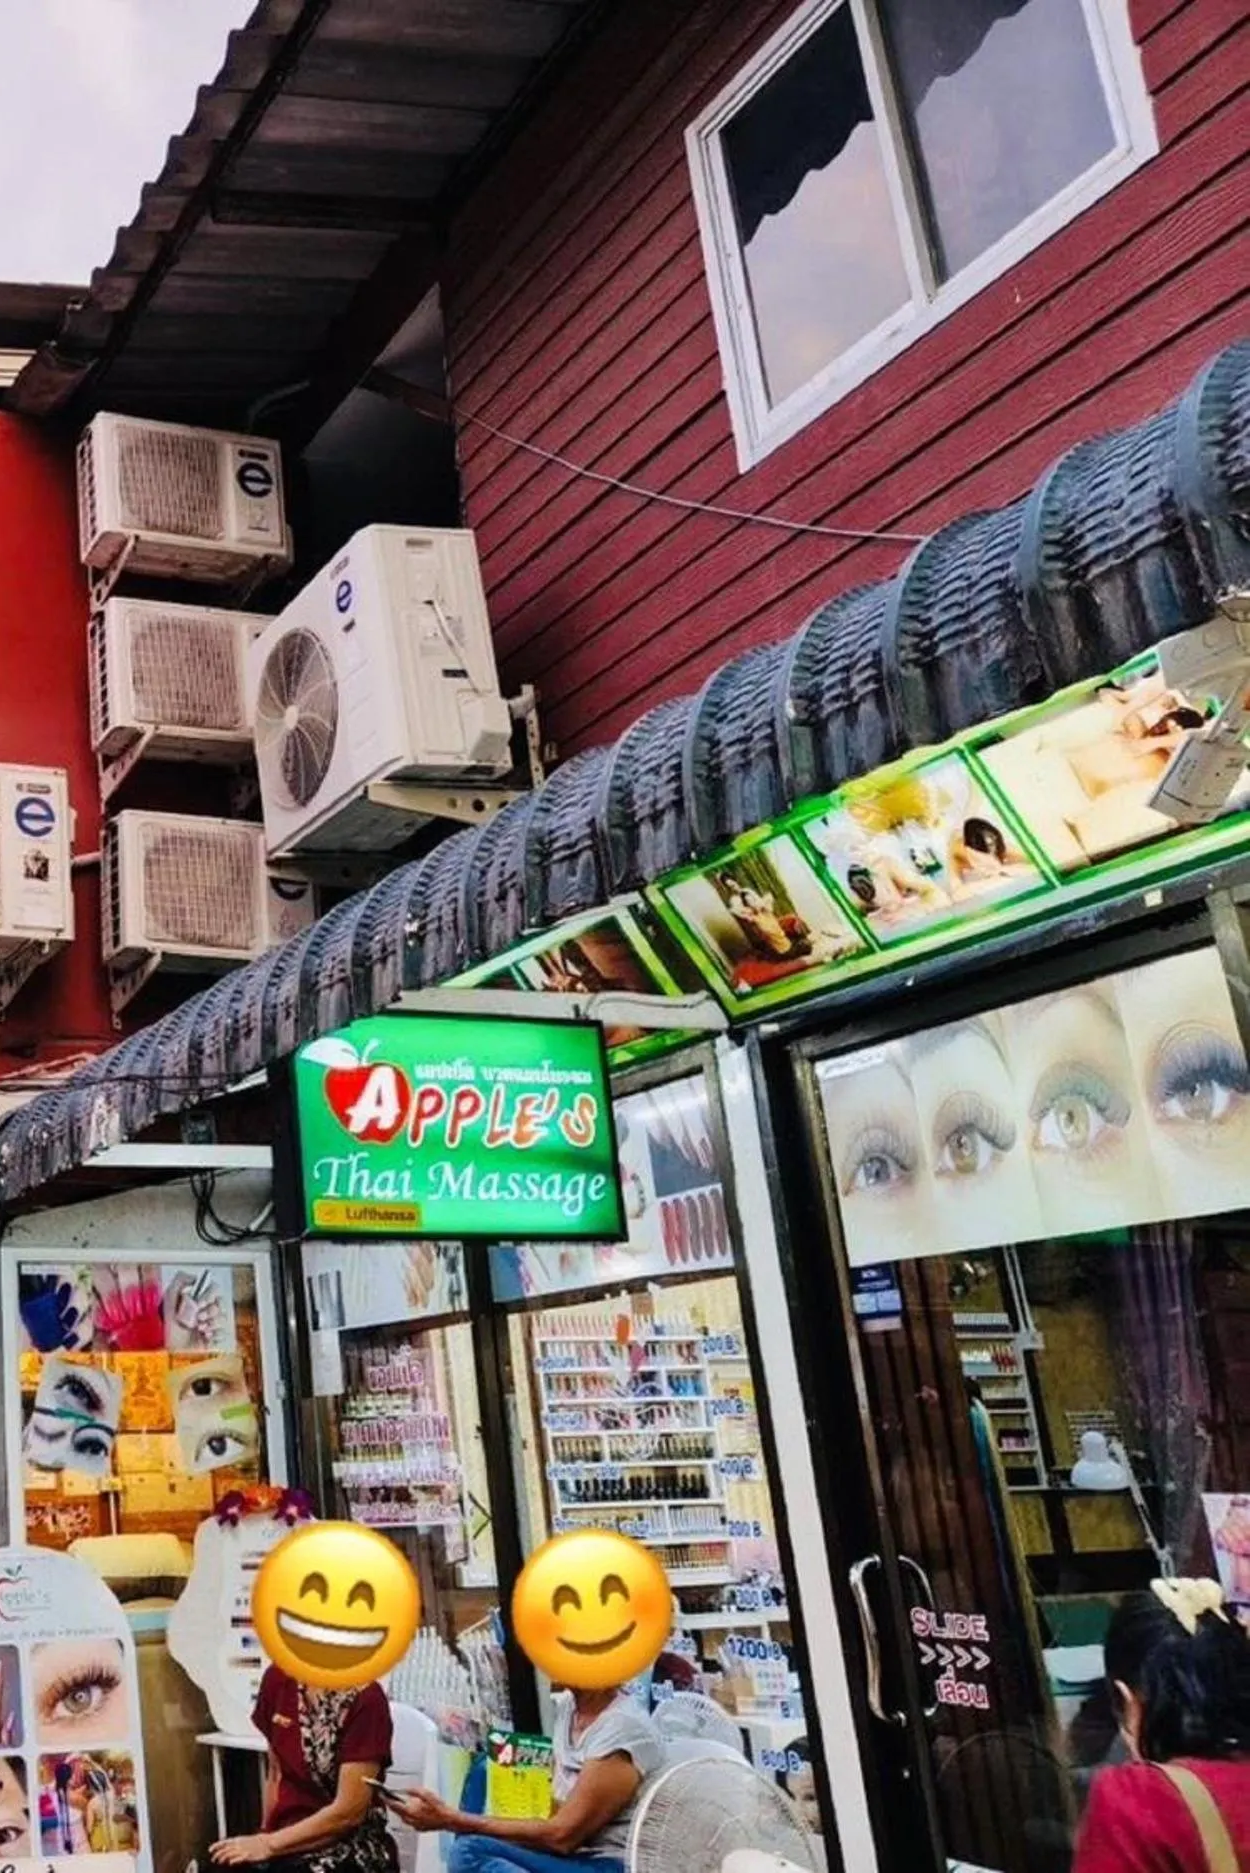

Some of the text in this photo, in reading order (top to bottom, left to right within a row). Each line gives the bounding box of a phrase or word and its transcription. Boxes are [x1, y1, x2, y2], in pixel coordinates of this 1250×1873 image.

[313, 1151, 607, 1217] Thai Massage
[344, 1204, 417, 1223] Lufthansa
[910, 1606, 991, 1643] SLIDE
[726, 1636, 768, 1661] 1200
